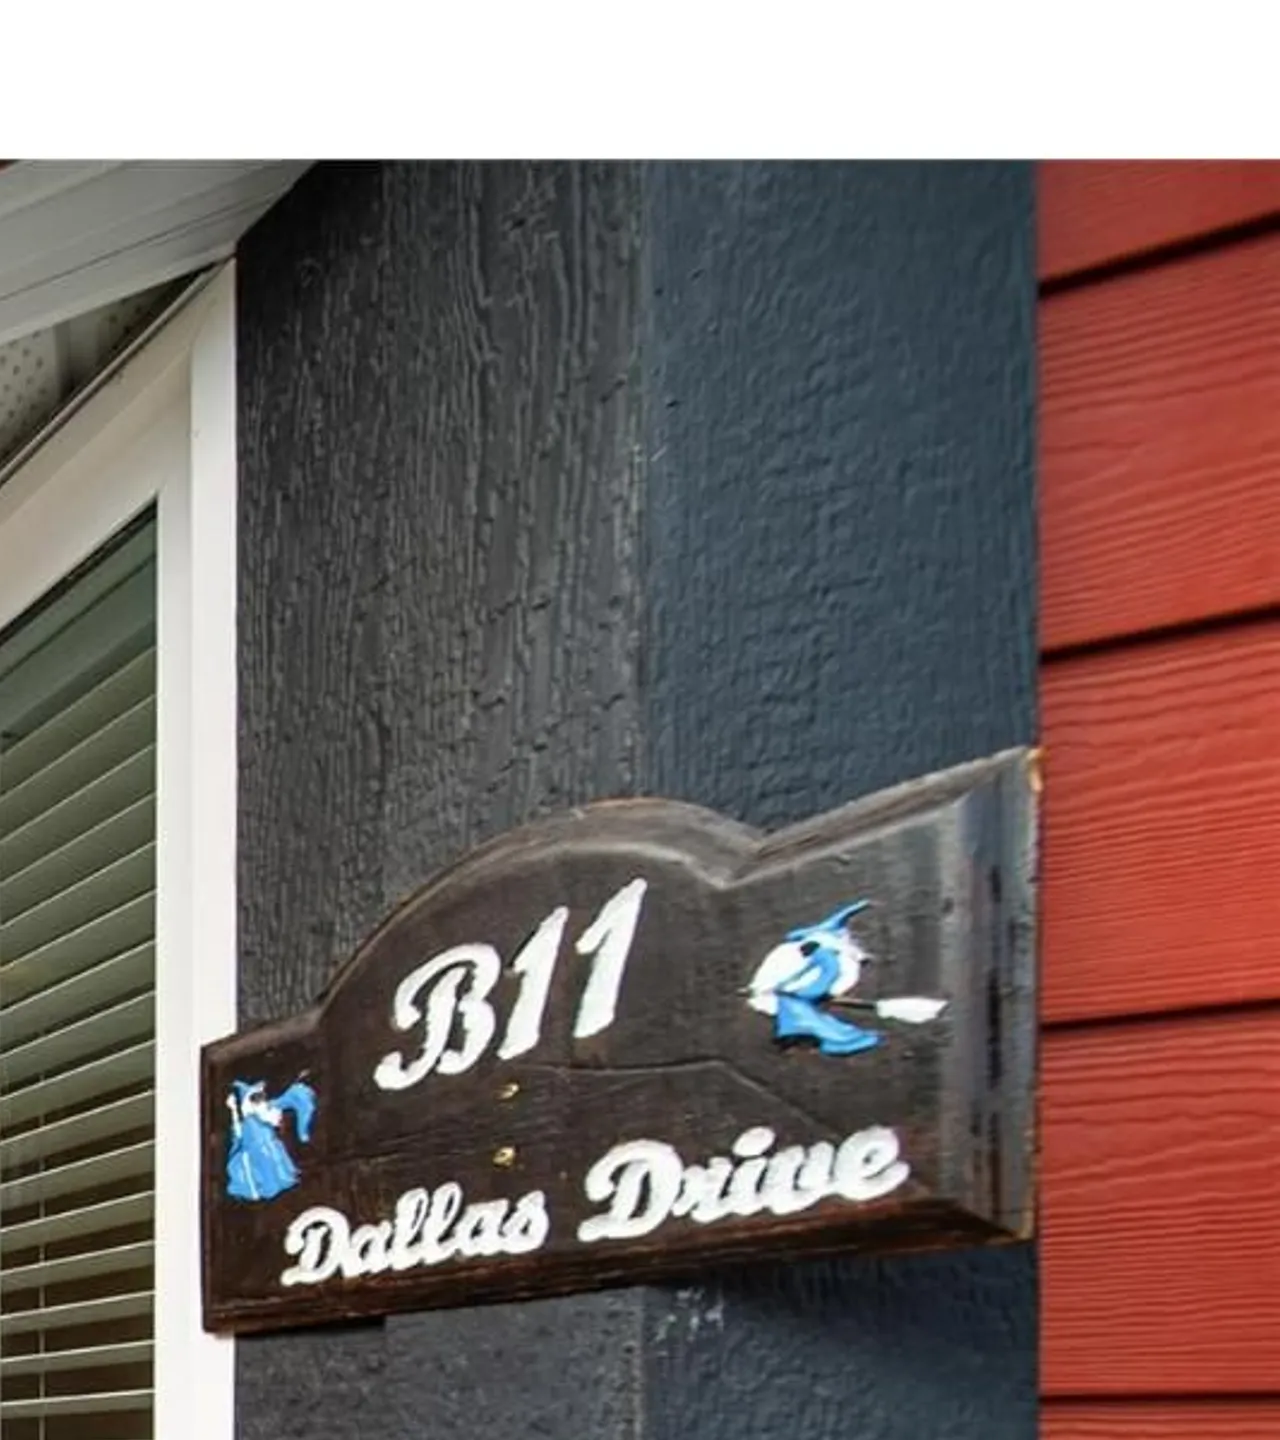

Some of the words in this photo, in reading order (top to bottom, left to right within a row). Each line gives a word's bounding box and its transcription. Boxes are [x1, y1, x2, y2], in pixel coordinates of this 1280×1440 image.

[373, 877, 649, 1091] B11
[280, 1182, 549, 1286] Dallas
[577, 1126, 910, 1242] Drive
